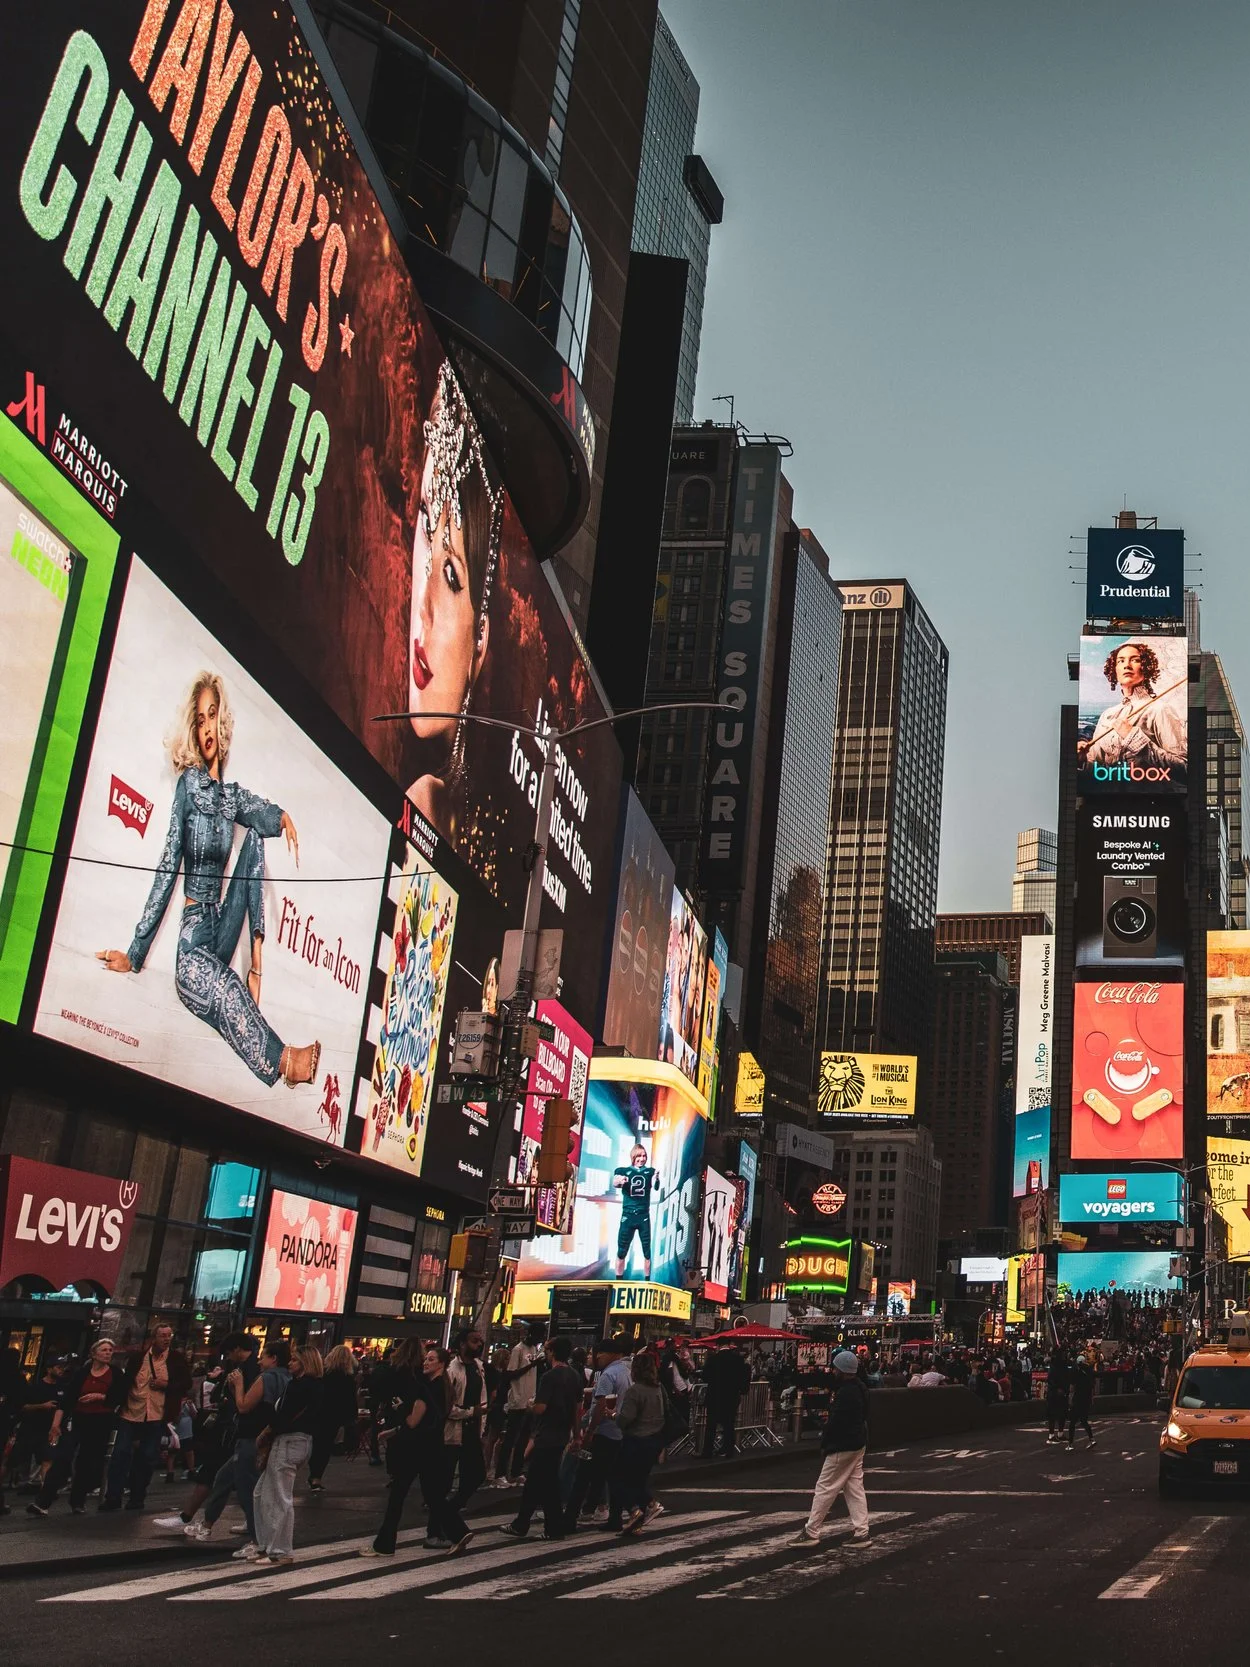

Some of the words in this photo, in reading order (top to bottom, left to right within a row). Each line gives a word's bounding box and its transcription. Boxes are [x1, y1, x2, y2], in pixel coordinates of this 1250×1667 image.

[20, 29, 283, 512] CHANNEL
[266, 383, 330, 567] 13
[59, 413, 128, 498] MARRIOTT
[672, 451, 706, 461] UARE
[54, 437, 116, 513] MARQUIS
[17, 512, 66, 567] swatch
[727, 466, 764, 624] TIMES
[1099, 584, 1171, 598] Prudential
[707, 651, 748, 860] SQUARE
[1093, 760, 1171, 782] britbox
[566, 766, 589, 823] now
[508, 730, 530, 792] for
[528, 774, 539, 809] a
[570, 819, 593, 895] time,
[1092, 814, 1171, 829] SAMSUNG
[413, 813, 439, 846] MARRIOTT
[1103, 840, 1142, 851] Bespoke
[1142, 841, 1151, 849] AI
[1096, 852, 1133, 862] Laundry
[1134, 852, 1165, 861] Vented
[301, 914, 325, 967] for
[322, 948, 334, 972] an
[333, 936, 361, 995] Icon
[1041, 943, 1051, 977] Malvasi
[1040, 979, 1051, 1011] Greene
[1094, 981, 1163, 1005] Coca-Cola
[1040, 1013, 1051, 1033] Meg
[537, 1042, 566, 1084] BILLBOARD
[1113, 1050, 1145, 1062] Coca-Cola
[880, 1064, 909, 1074] WORLD'S
[880, 1073, 909, 1083] MUSICAL
[453, 1086, 465, 1101] W
[871, 1094, 888, 1106] LION
[888, 1095, 908, 1107] KING
[637, 1115, 671, 1132] hulu
[1217, 1164, 1234, 1181] the
[630, 1175, 647, 1198] 2
[1107, 1184, 1126, 1195] LEGO
[425, 1206, 445, 1221] SEPHORA
[1082, 1200, 1155, 1217] voyagers
[278, 1234, 339, 1272] PANDORA
[410, 1292, 446, 1316] SEPHORA
